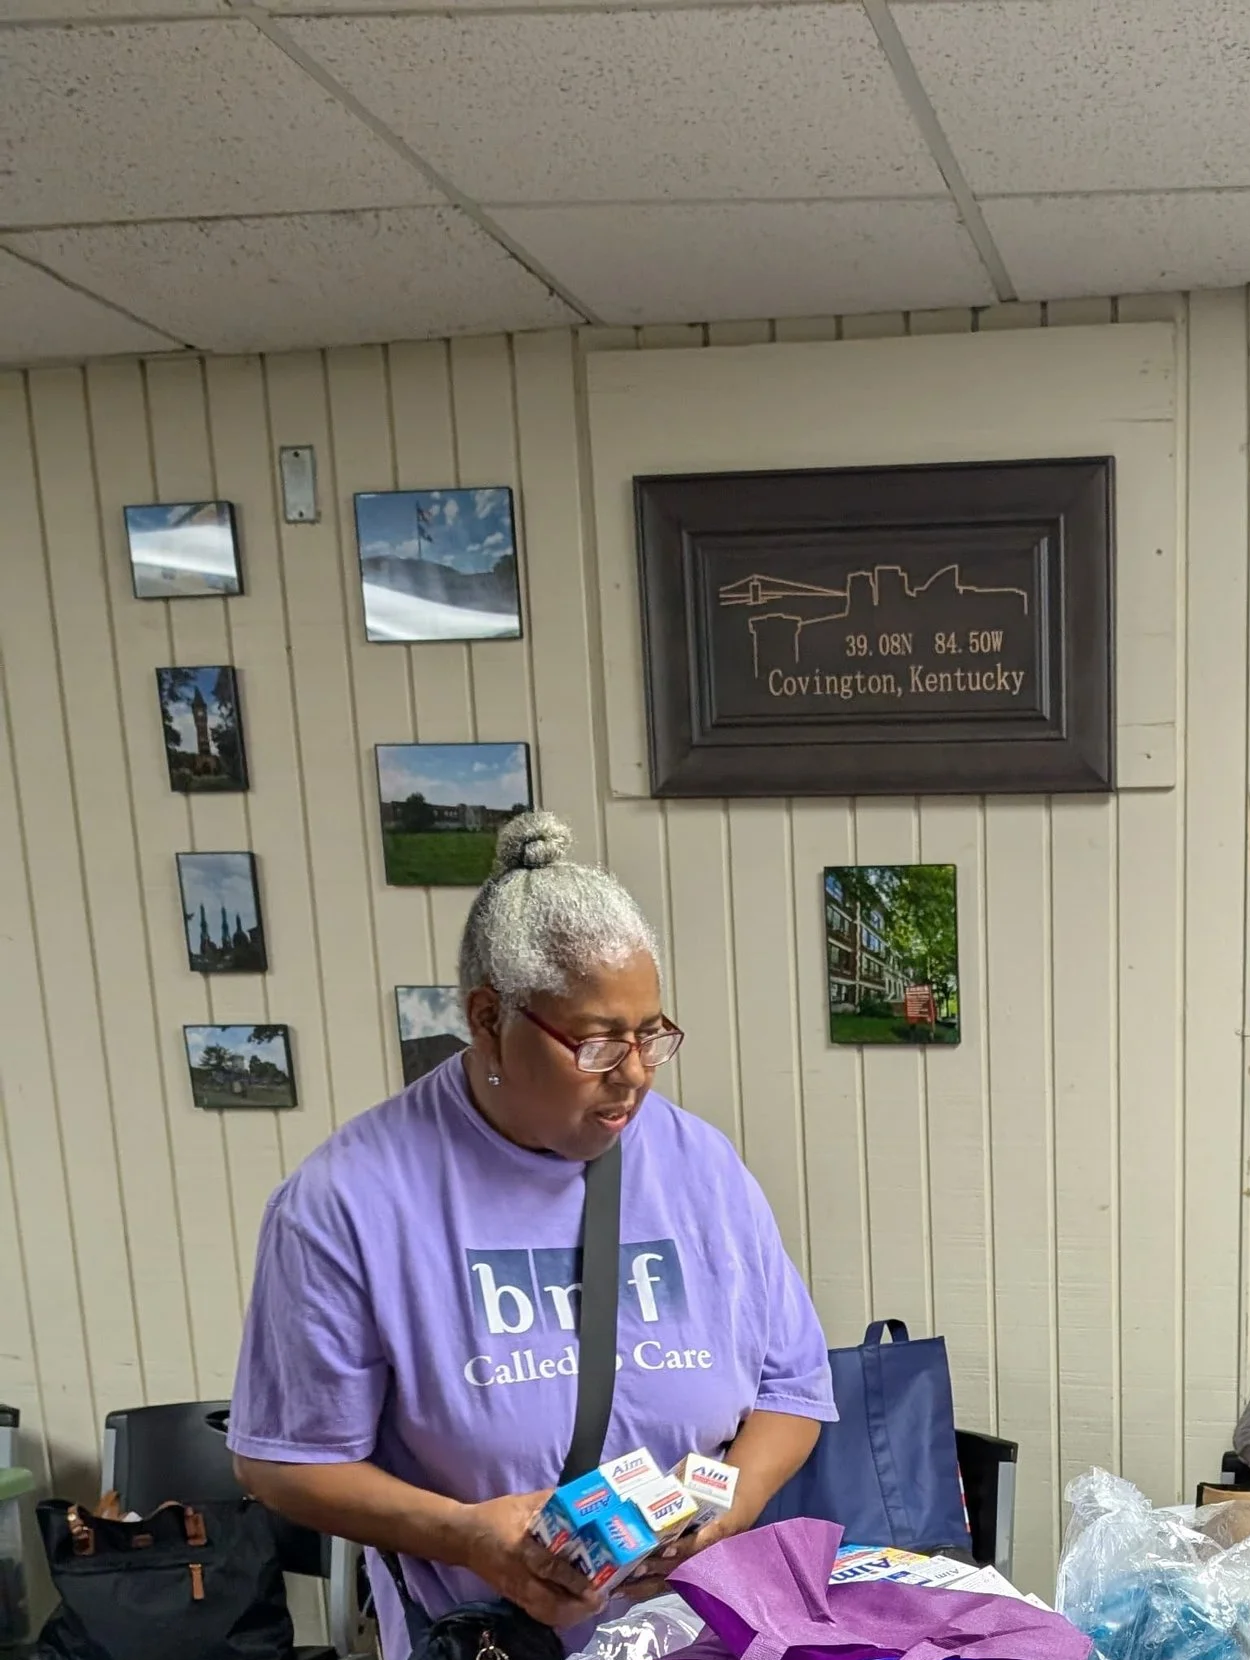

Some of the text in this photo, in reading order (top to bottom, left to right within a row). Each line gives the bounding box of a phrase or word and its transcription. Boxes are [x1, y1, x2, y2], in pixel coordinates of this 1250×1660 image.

[463, 1345, 580, 1387] Called
[632, 1340, 714, 1370] Care
[612, 1457, 644, 1478] Aim
[692, 1466, 729, 1483] Aim
[580, 1494, 612, 1517] Aim
[651, 1496, 685, 1521] Aim
[831, 1556, 892, 1582] Aim
[934, 1568, 960, 1579] Aim
